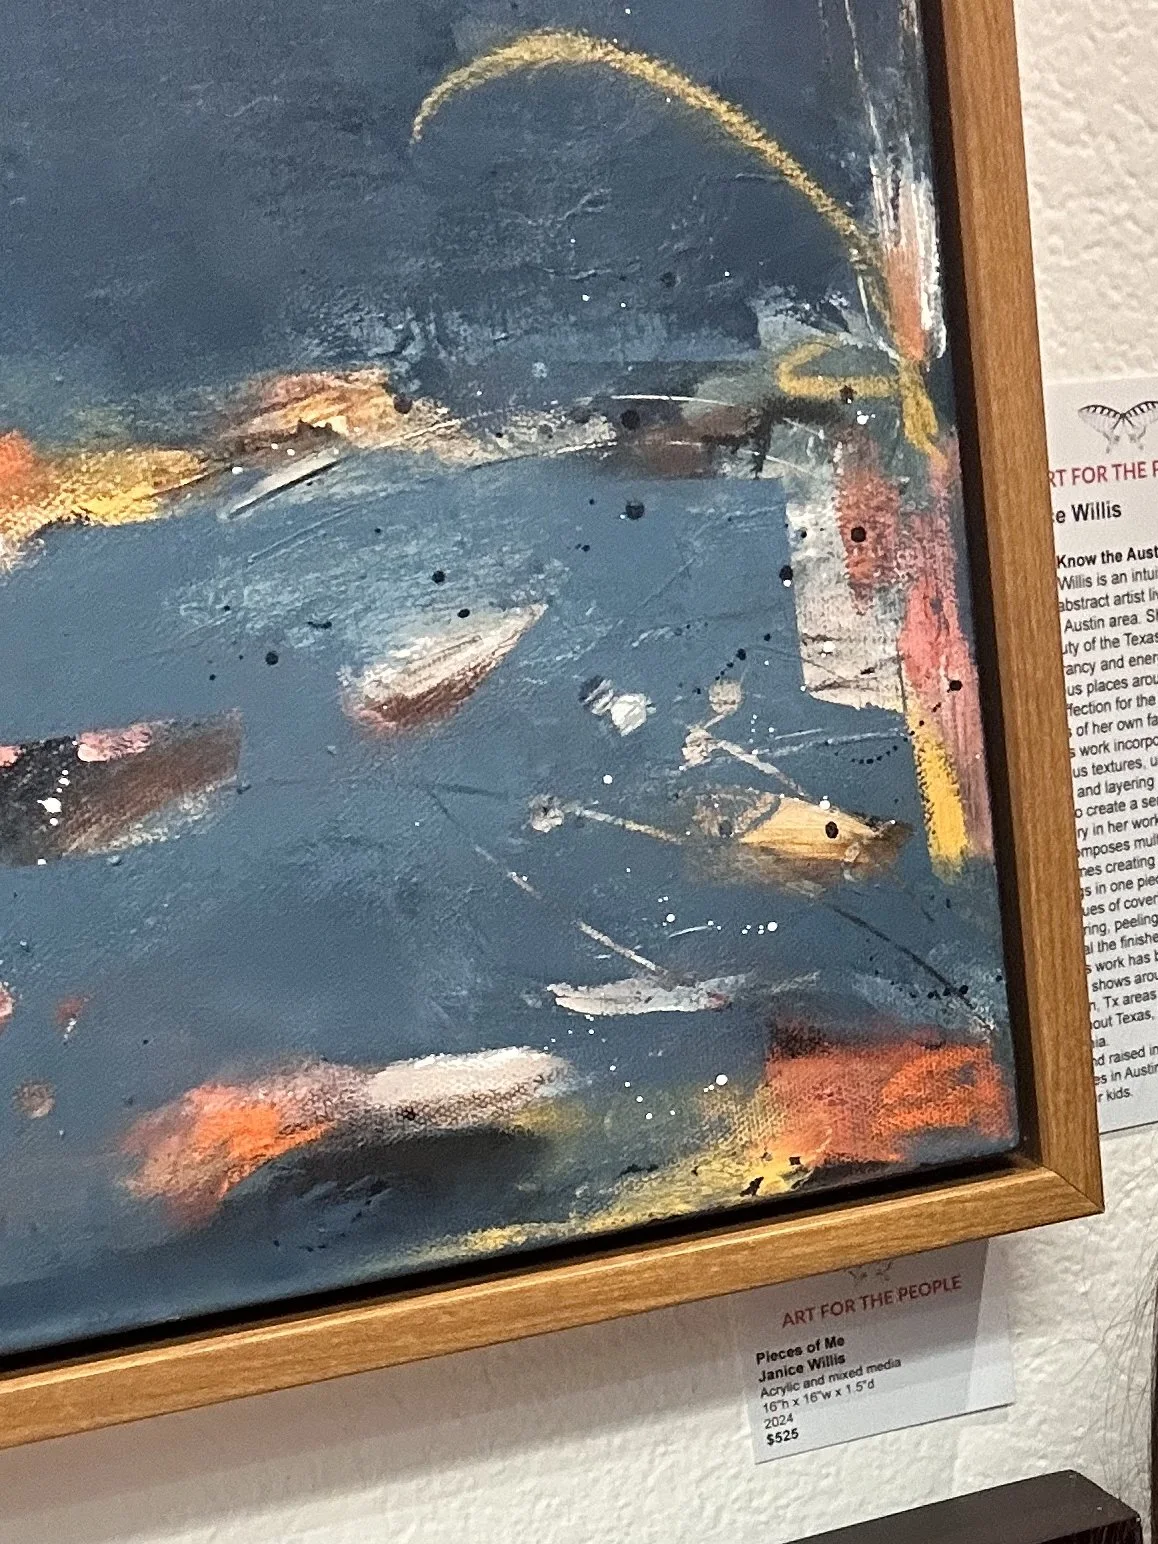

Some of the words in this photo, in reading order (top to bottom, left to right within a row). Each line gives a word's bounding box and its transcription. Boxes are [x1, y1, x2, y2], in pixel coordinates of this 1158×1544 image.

[1072, 465, 1108, 485] FOR
[1112, 461, 1147, 480] THE
[1071, 500, 1121, 522] Willis
[1057, 554, 1096, 569] Know
[1102, 550, 1123, 564] the
[1058, 575, 1092, 590] Willis
[1097, 575, 1107, 587] is
[1112, 571, 1127, 584] an
[1114, 590, 1145, 605] artist
[1065, 618, 1105, 633] Austin
[1084, 638, 1096, 652] of
[1100, 635, 1120, 649] the
[1101, 656, 1124, 672] and
[1068, 683, 1082, 696] us
[1087, 677, 1128, 697] places
[1116, 697, 1132, 710] for
[1137, 694, 1156, 708] the
[1076, 723, 1088, 737] of
[1092, 719, 1112, 734] her
[1117, 717, 1143, 731] own
[1080, 741, 1110, 756] work
[1073, 765, 1088, 778] us
[1077, 783, 1101, 798] and
[1105, 776, 1154, 796] layering
[1087, 799, 1126, 817] create
[1130, 798, 1138, 809] a
[1078, 827, 1088, 841] ry
[1093, 822, 1103, 836] in
[1108, 819, 1128, 833] her
[1106, 854, 1155, 873] creating
[1096, 881, 1106, 895] in
[1110, 879, 1133, 893] one
[1108, 899, 1121, 912] of
[1114, 912, 1158, 933] peeling
[1097, 937, 1117, 952] the
[1095, 956, 1125, 972] work
[1128, 951, 1150, 966] has
[1092, 976, 1131, 991] shows
[1104, 995, 1119, 1008] Tx
[1123, 989, 1157, 1005] areas
[1109, 1047, 1145, 1065] raised
[1150, 1045, 1158, 1058] in
[1111, 1069, 1122, 1082] in
[782, 1307, 815, 1328] ART
[820, 1300, 855, 1324] FOR
[859, 1290, 893, 1312] THE
[898, 1275, 962, 1301] PEOPLE
[756, 1345, 803, 1365] Pieces
[807, 1339, 821, 1353] of
[824, 1336, 845, 1350] Me
[758, 1364, 804, 1383] Janice
[807, 1354, 846, 1372] Willis
[760, 1381, 800, 1398] Acrylic
[803, 1377, 825, 1389] and
[828, 1367, 864, 1382] mixed
[866, 1358, 902, 1374] media
[764, 1413, 794, 1429] 2024
[767, 1428, 799, 1446] $525
